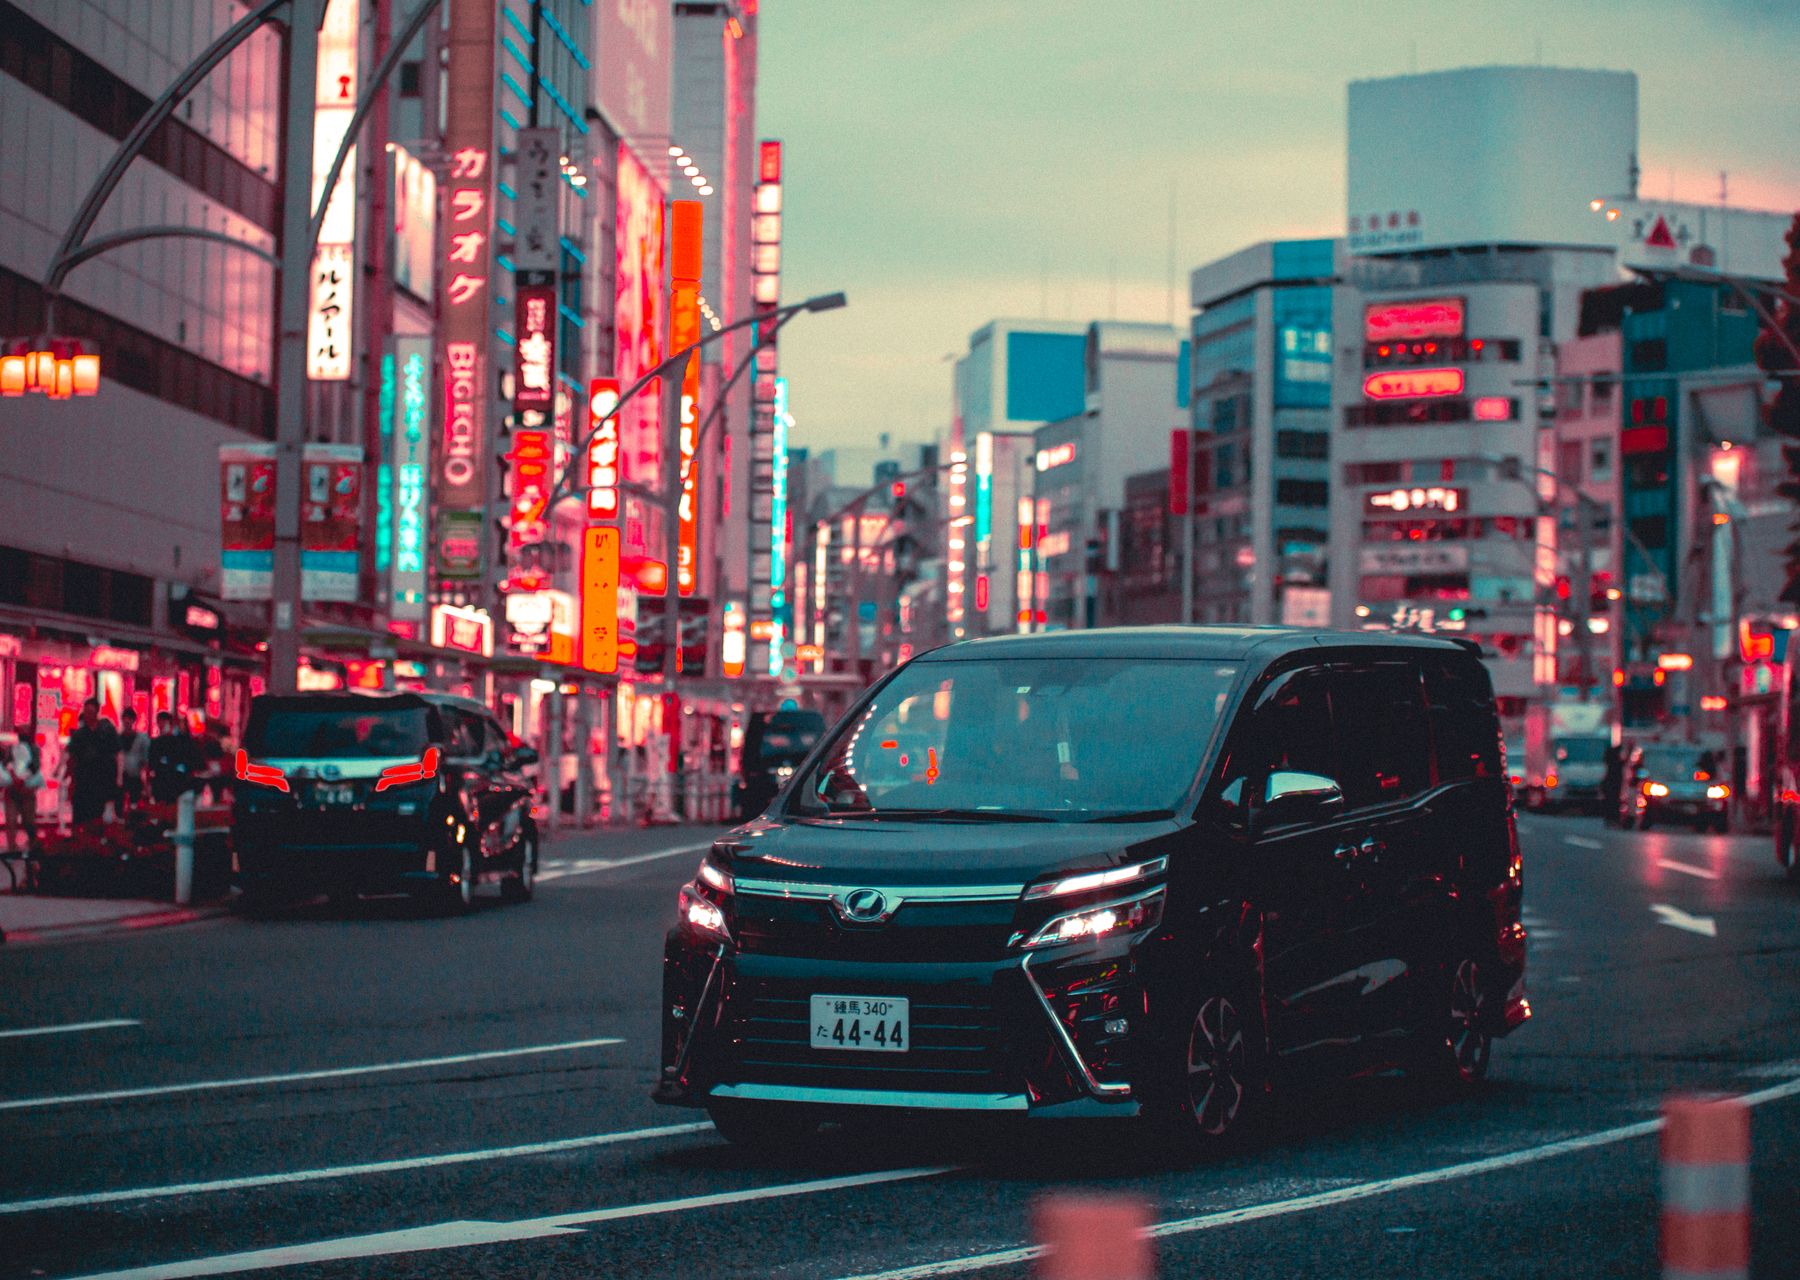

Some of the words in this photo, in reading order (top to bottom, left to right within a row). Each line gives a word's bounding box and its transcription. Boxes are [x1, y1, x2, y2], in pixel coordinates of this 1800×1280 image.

[449, 148, 486, 304] カラオケ
[317, 269, 342, 359] ルノアール
[816, 1025, 829, 1038] た
[832, 1018, 904, 1048] 44-44
[834, 1000, 860, 1015] 練馬
[863, 1001, 888, 1016] 340
